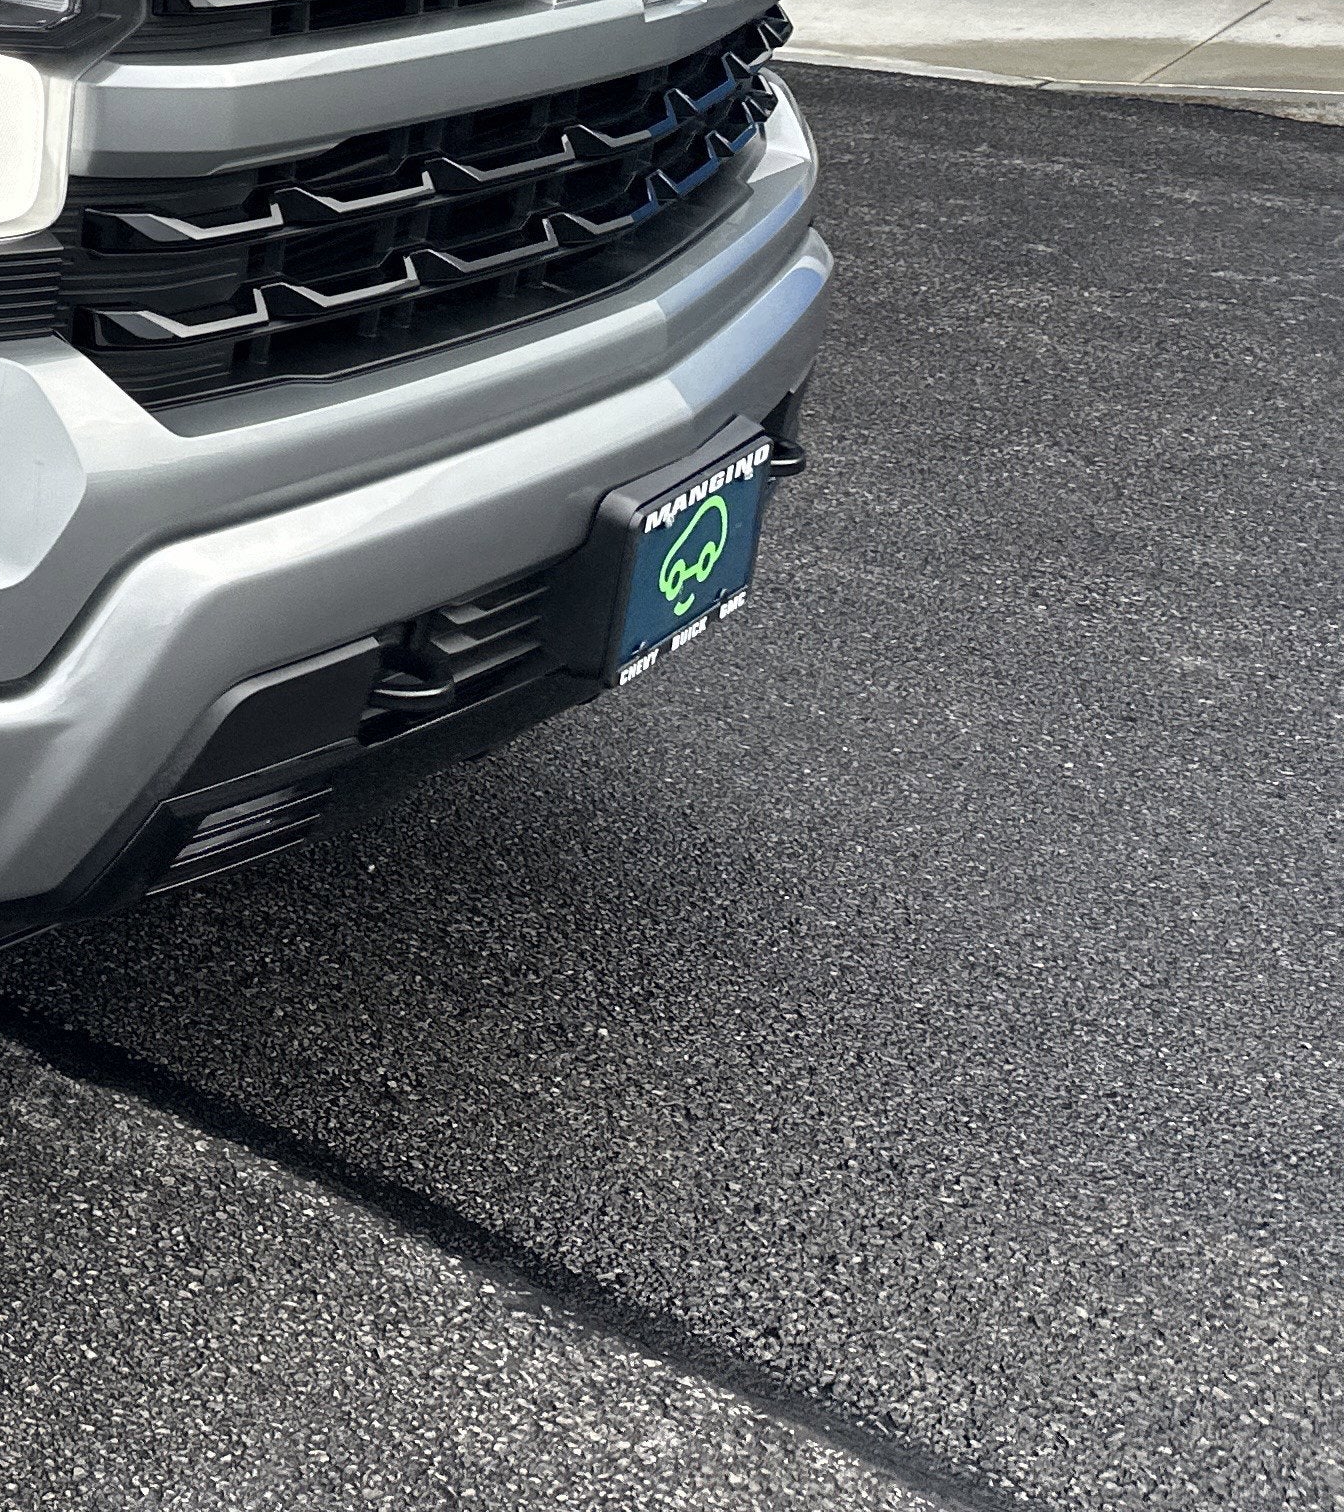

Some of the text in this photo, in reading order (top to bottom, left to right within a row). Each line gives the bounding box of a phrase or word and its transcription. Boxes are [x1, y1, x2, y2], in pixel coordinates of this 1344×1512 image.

[644, 443, 770, 533] MANGINO
[619, 591, 747, 686] CHEVY BUICK GMC
